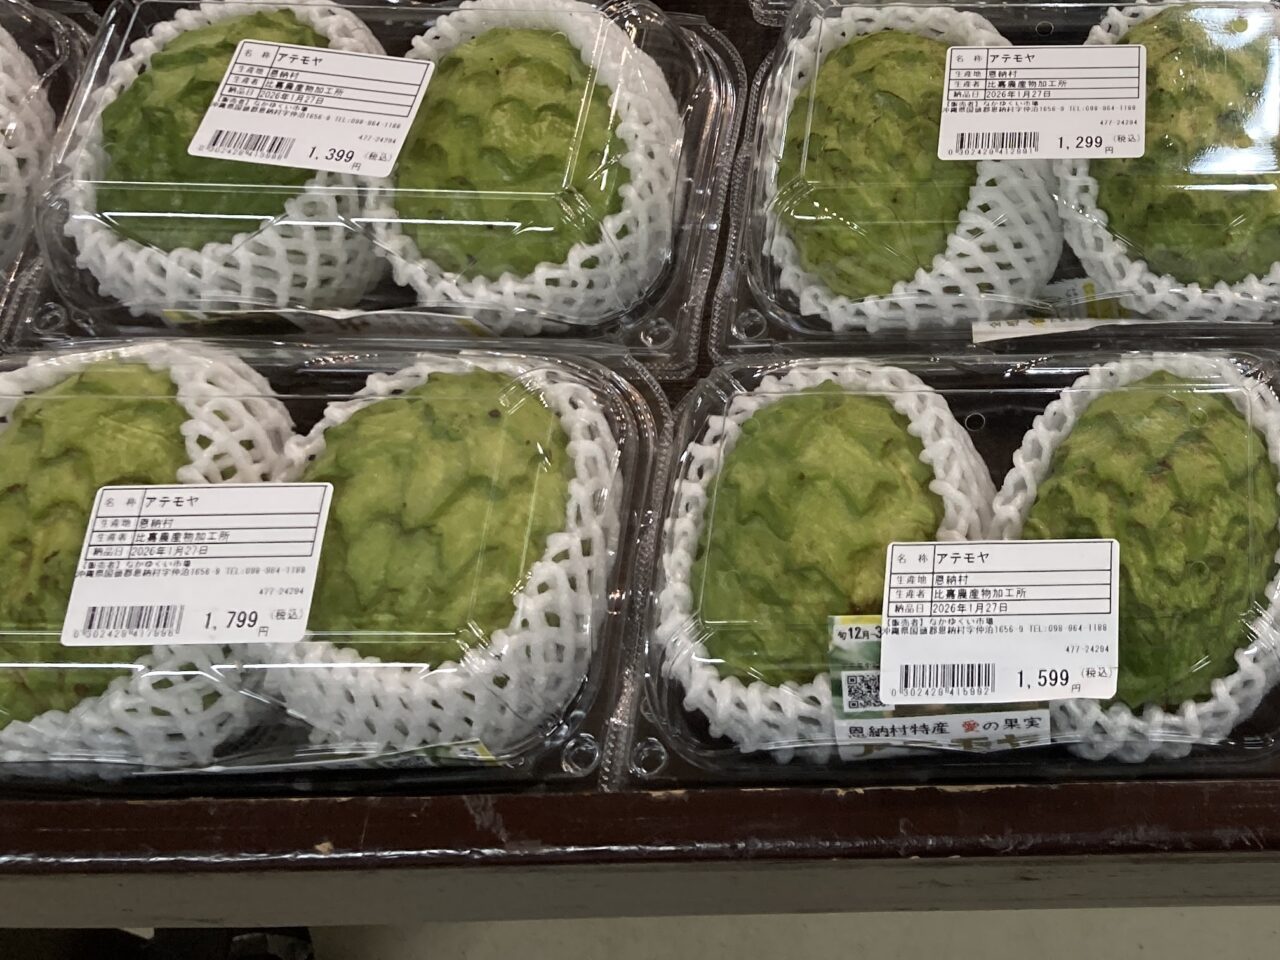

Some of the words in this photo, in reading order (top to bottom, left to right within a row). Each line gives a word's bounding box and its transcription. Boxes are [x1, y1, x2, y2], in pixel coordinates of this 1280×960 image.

[989, 54, 1035, 62] アテモヤ
[1057, 136, 1103, 150] 1,299
[306, 145, 356, 165] 1,399
[144, 496, 201, 507] アテモヤ
[138, 518, 175, 528] 恩納村
[936, 552, 990, 564] アテモヤ
[934, 574, 969, 585] 恩納村
[932, 602, 1008, 614] 2026年1月27日
[202, 611, 260, 631] 1,799
[1017, 669, 1070, 689] 1,599
[848, 722, 950, 738] 恩納村特産
[962, 717, 1042, 732] 愛の果実
